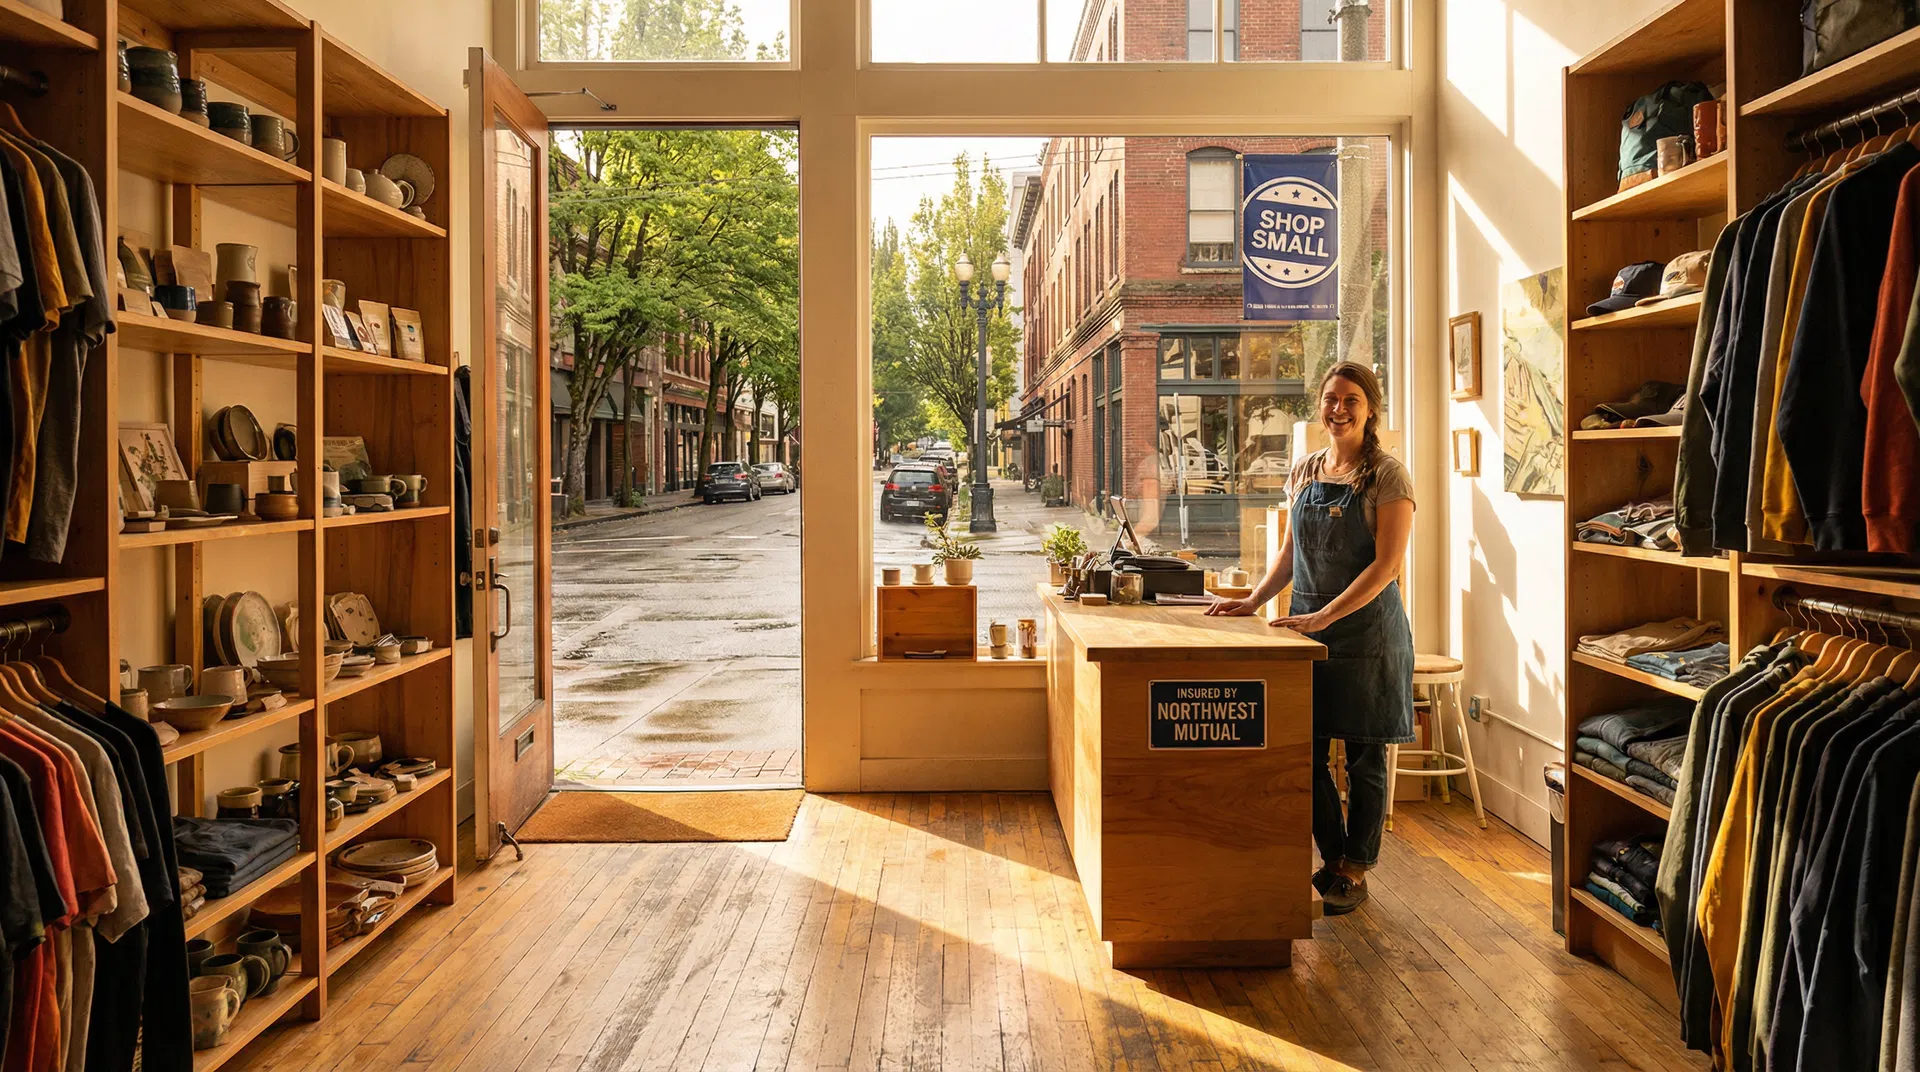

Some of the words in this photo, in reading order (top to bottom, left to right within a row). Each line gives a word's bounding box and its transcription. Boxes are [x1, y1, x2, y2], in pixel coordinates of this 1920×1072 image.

[1259, 209, 1326, 235] SHOP
[1251, 229, 1330, 258] SMALL
[1177, 687, 1221, 699] INSURED
[1224, 687, 1238, 699] BY
[1157, 701, 1258, 720] NORTHWEST
[1174, 723, 1241, 741] MUTUAL
